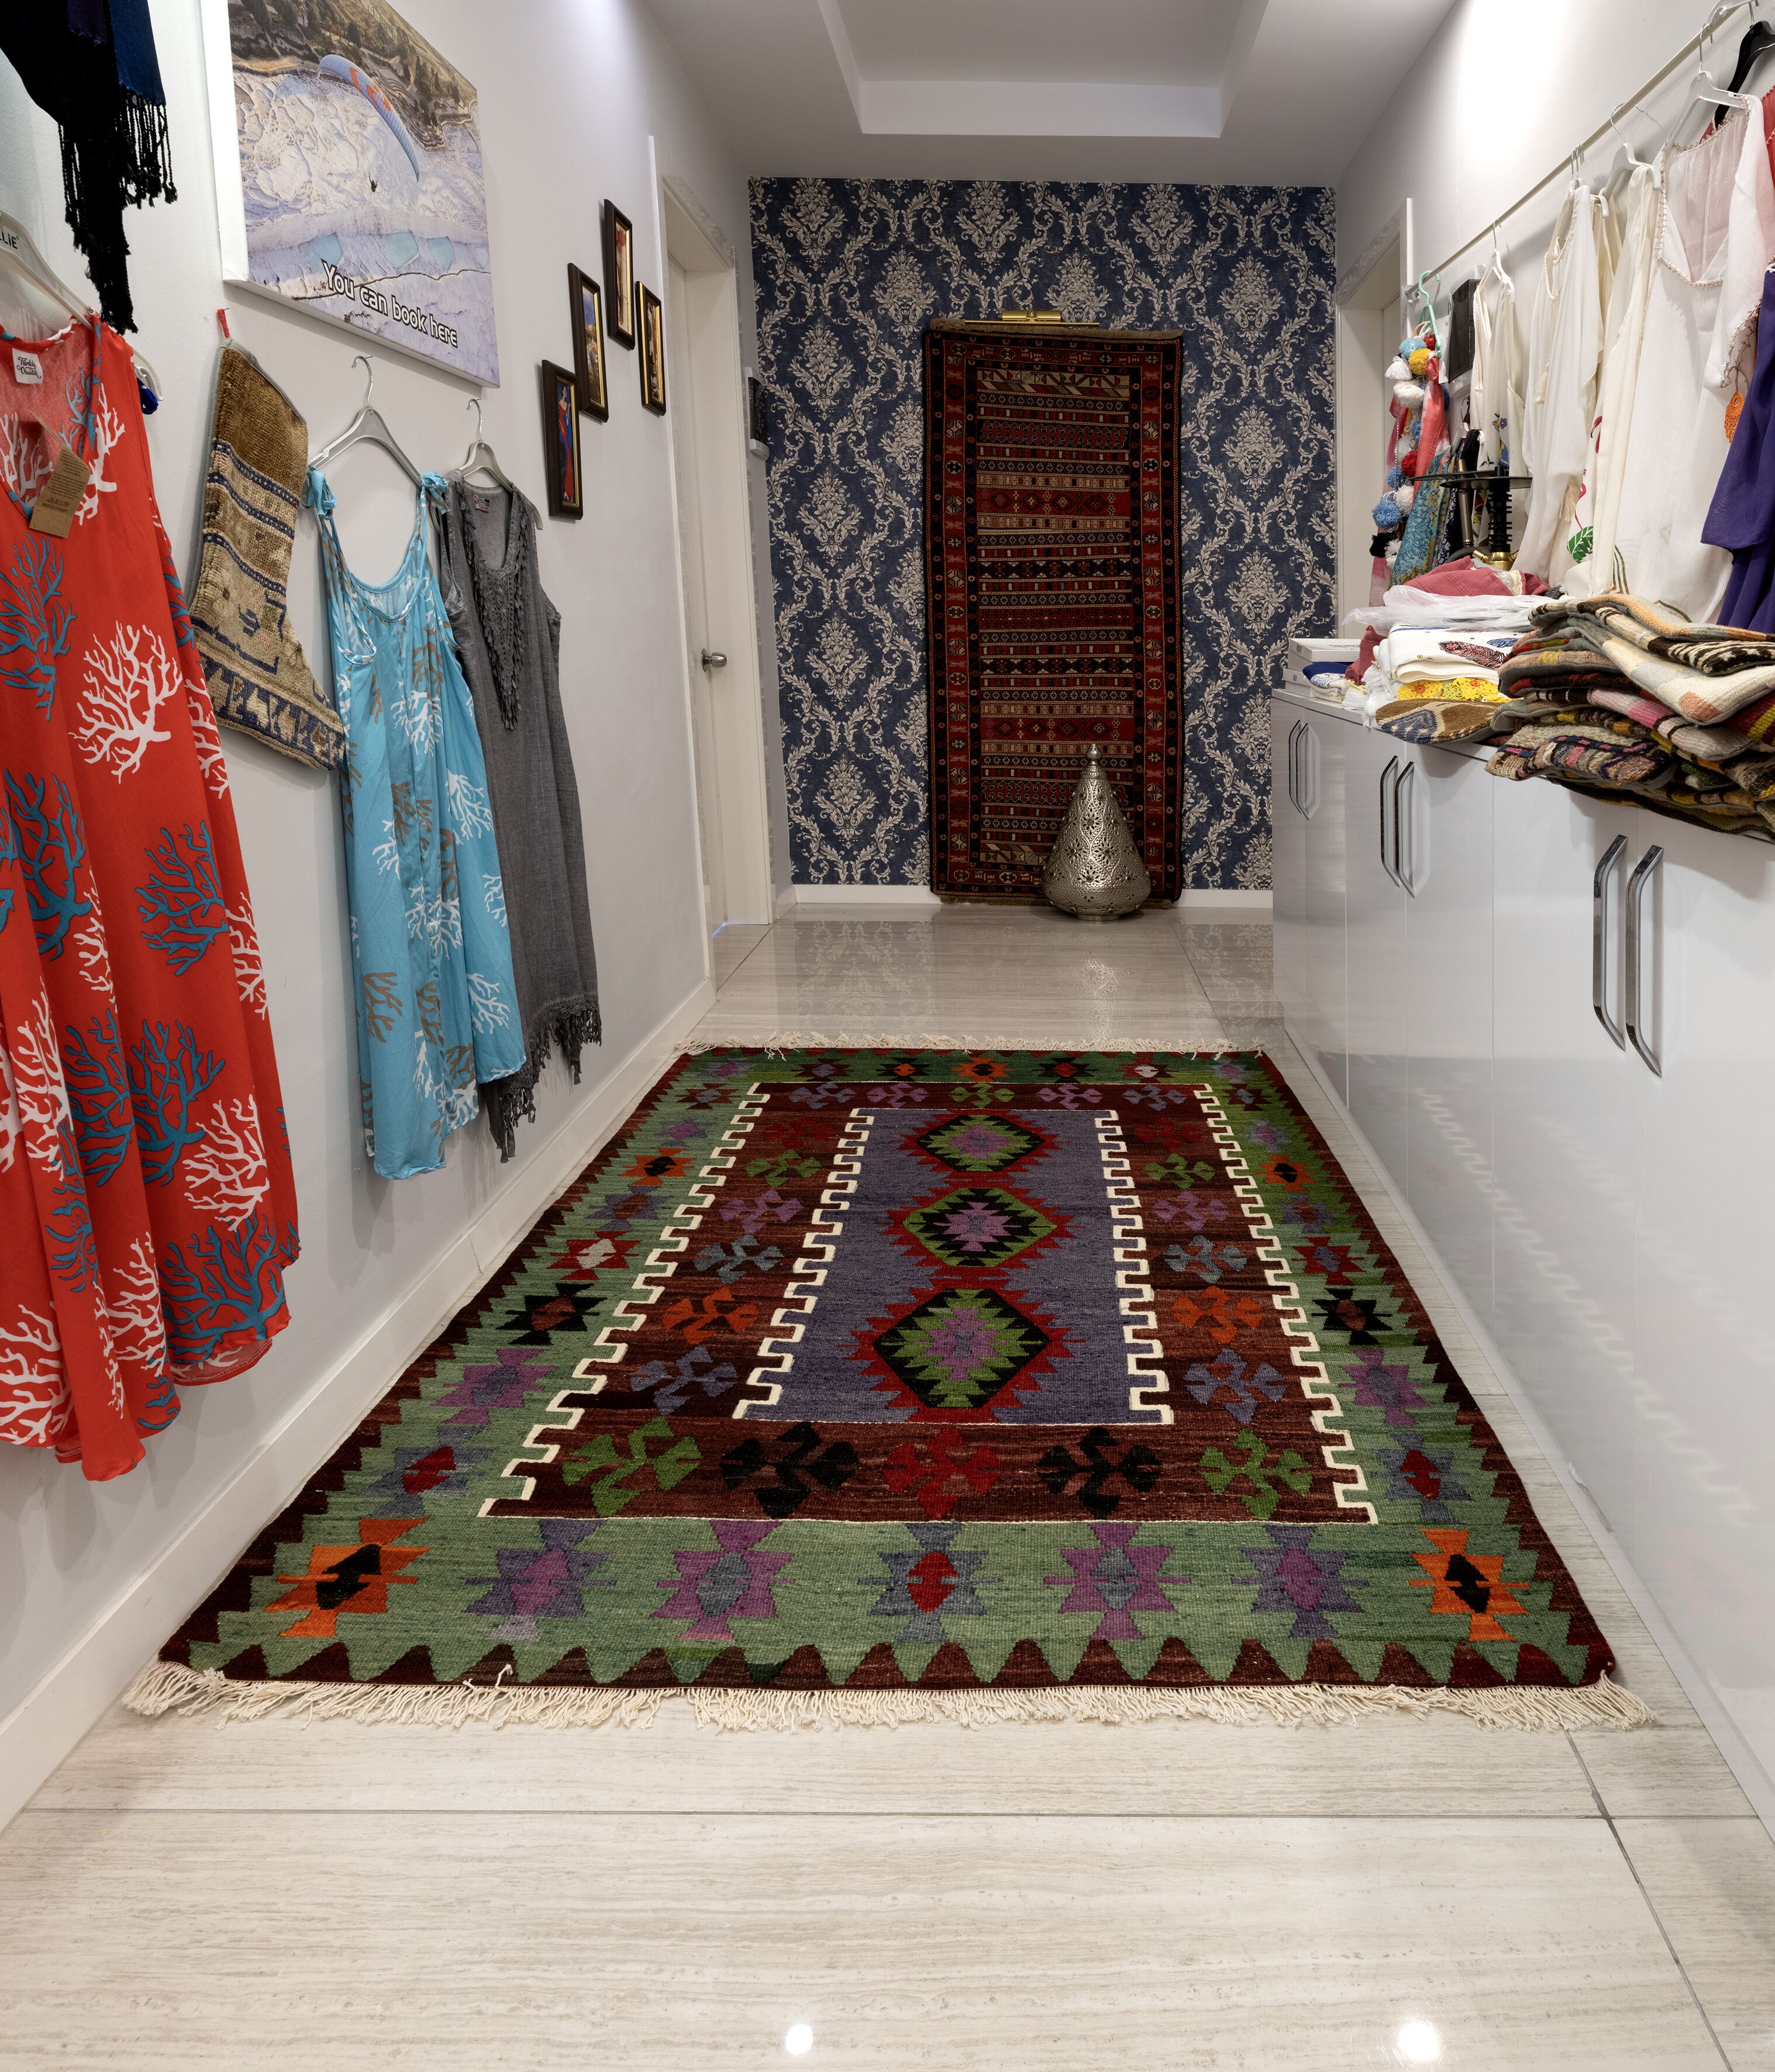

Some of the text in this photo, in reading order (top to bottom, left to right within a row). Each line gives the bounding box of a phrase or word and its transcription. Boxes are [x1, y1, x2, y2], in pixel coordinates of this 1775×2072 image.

[321, 258, 458, 349] You can book here
